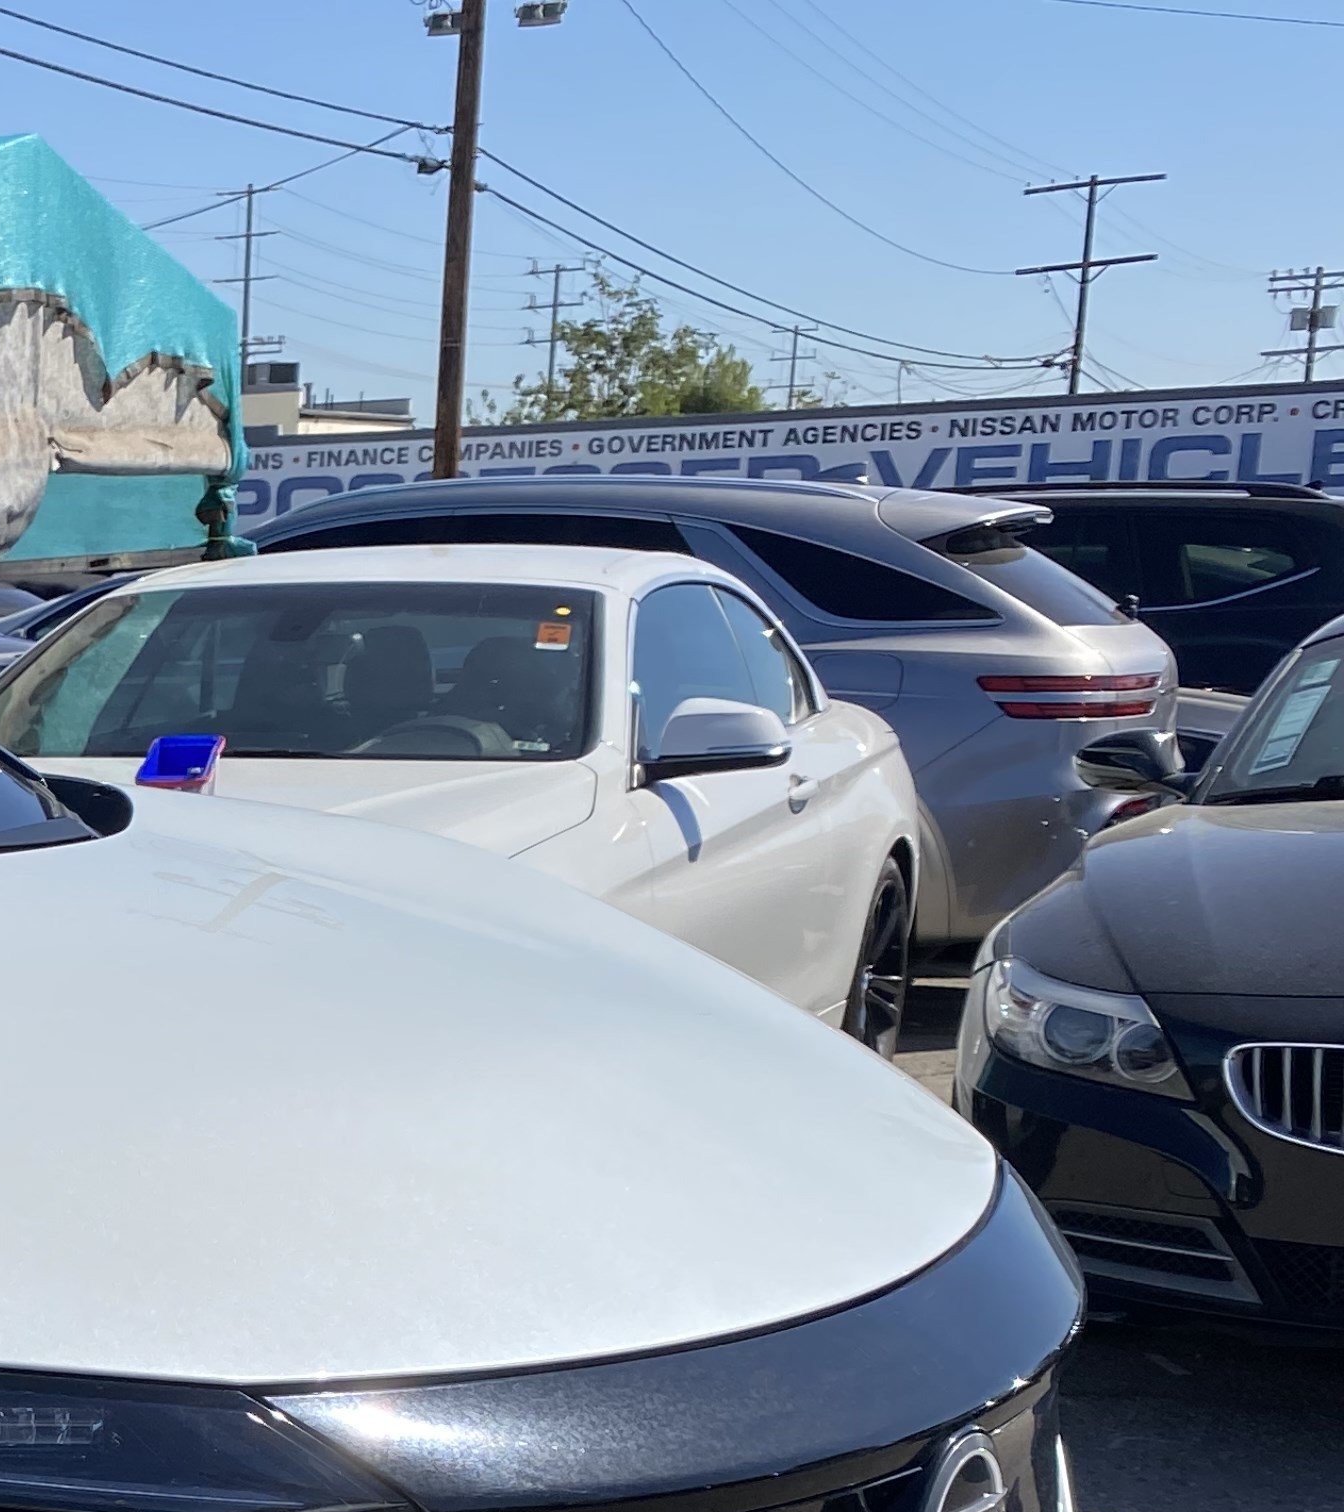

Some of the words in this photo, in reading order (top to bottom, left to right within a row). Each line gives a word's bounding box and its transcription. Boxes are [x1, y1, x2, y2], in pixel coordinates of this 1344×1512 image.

[306, 447, 409, 468] FINANCE
[418, 439, 563, 463] CMPANIES
[588, 428, 774, 455] GOVERNMENT
[782, 420, 924, 447] AGENCIES
[947, 413, 1061, 439] NISSAN
[1071, 407, 1180, 433] MOTOR
[1192, 402, 1279, 426] CORP.
